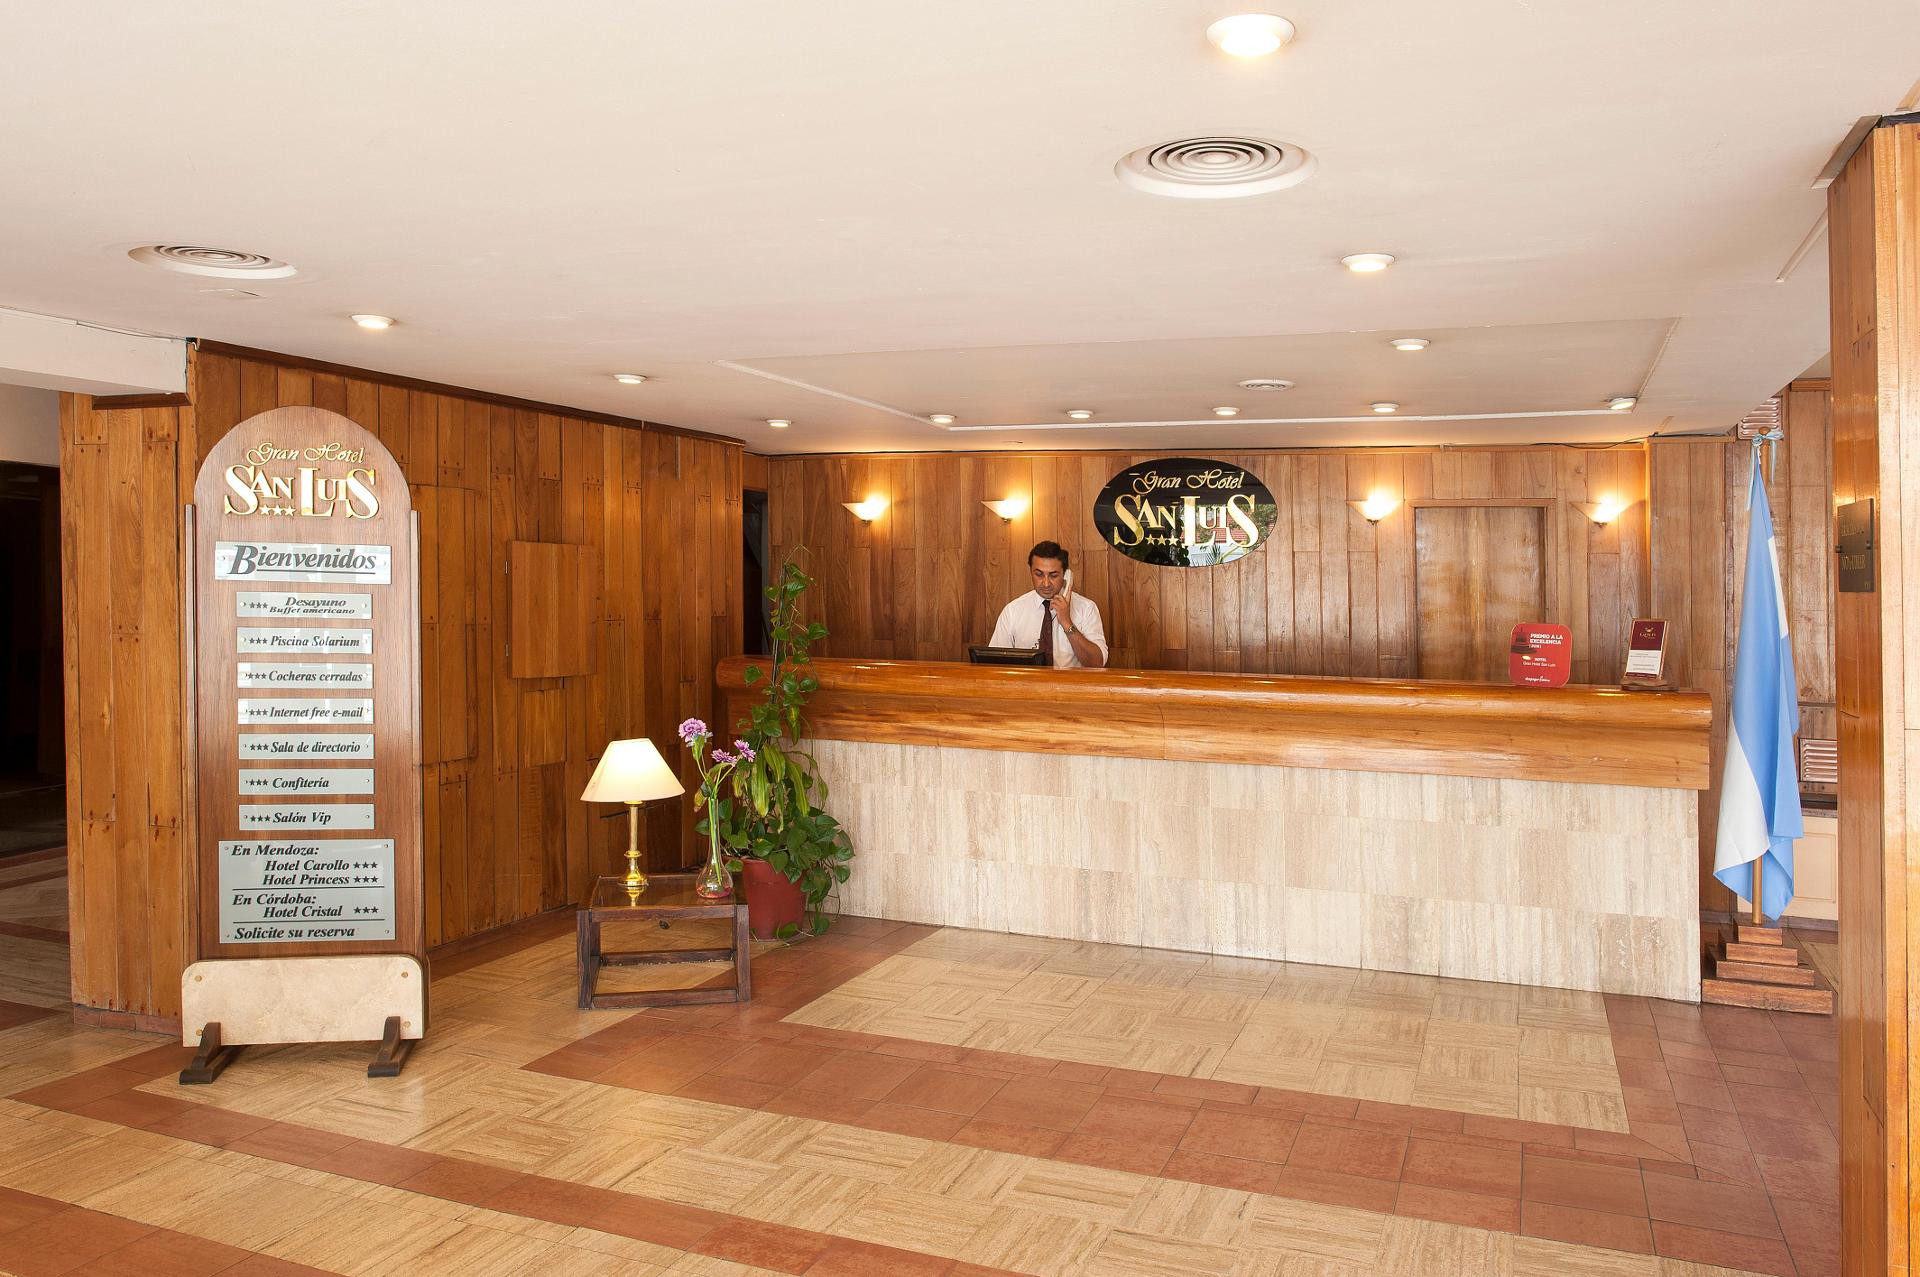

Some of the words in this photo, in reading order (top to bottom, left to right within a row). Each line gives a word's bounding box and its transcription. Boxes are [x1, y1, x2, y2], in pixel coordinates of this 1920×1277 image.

[246, 442, 298, 466] Gran
[303, 442, 365, 464] Hotel
[1132, 470, 1181, 494] Gran
[1186, 468, 1245, 490] Hotel
[226, 544, 377, 575] Bienvenidos
[285, 596, 347, 608] Desayuno
[269, 606, 301, 615] Buffet
[302, 607, 355, 615] americano
[270, 635, 309, 647] Piscina
[312, 635, 360, 647] Solarium
[268, 670, 317, 682] Cocheras
[319, 671, 363, 682] cerradas
[269, 706, 309, 718] Internet
[310, 707, 330, 720] free
[332, 706, 364, 718] e-mail
[270, 741, 294, 753] Sala
[296, 741, 309, 753] de
[311, 741, 361, 753] directorio
[272, 776, 330, 791] Confitería
[272, 811, 307, 824] Salón
[311, 811, 332, 825] Vip
[231, 844, 251, 856] En
[255, 844, 319, 856] Mendoza:
[264, 860, 300, 871] Hotel
[303, 859, 350, 871] Carollo
[262, 874, 296, 885] Hotel
[299, 874, 350, 885] Princess
[232, 894, 252, 906] En
[256, 893, 317, 905] Córdoba:
[263, 906, 298, 918] Hotel
[301, 905, 343, 917] Cristal
[234, 927, 284, 940] Solicite
[287, 929, 304, 939] su
[307, 927, 355, 938] reserva
